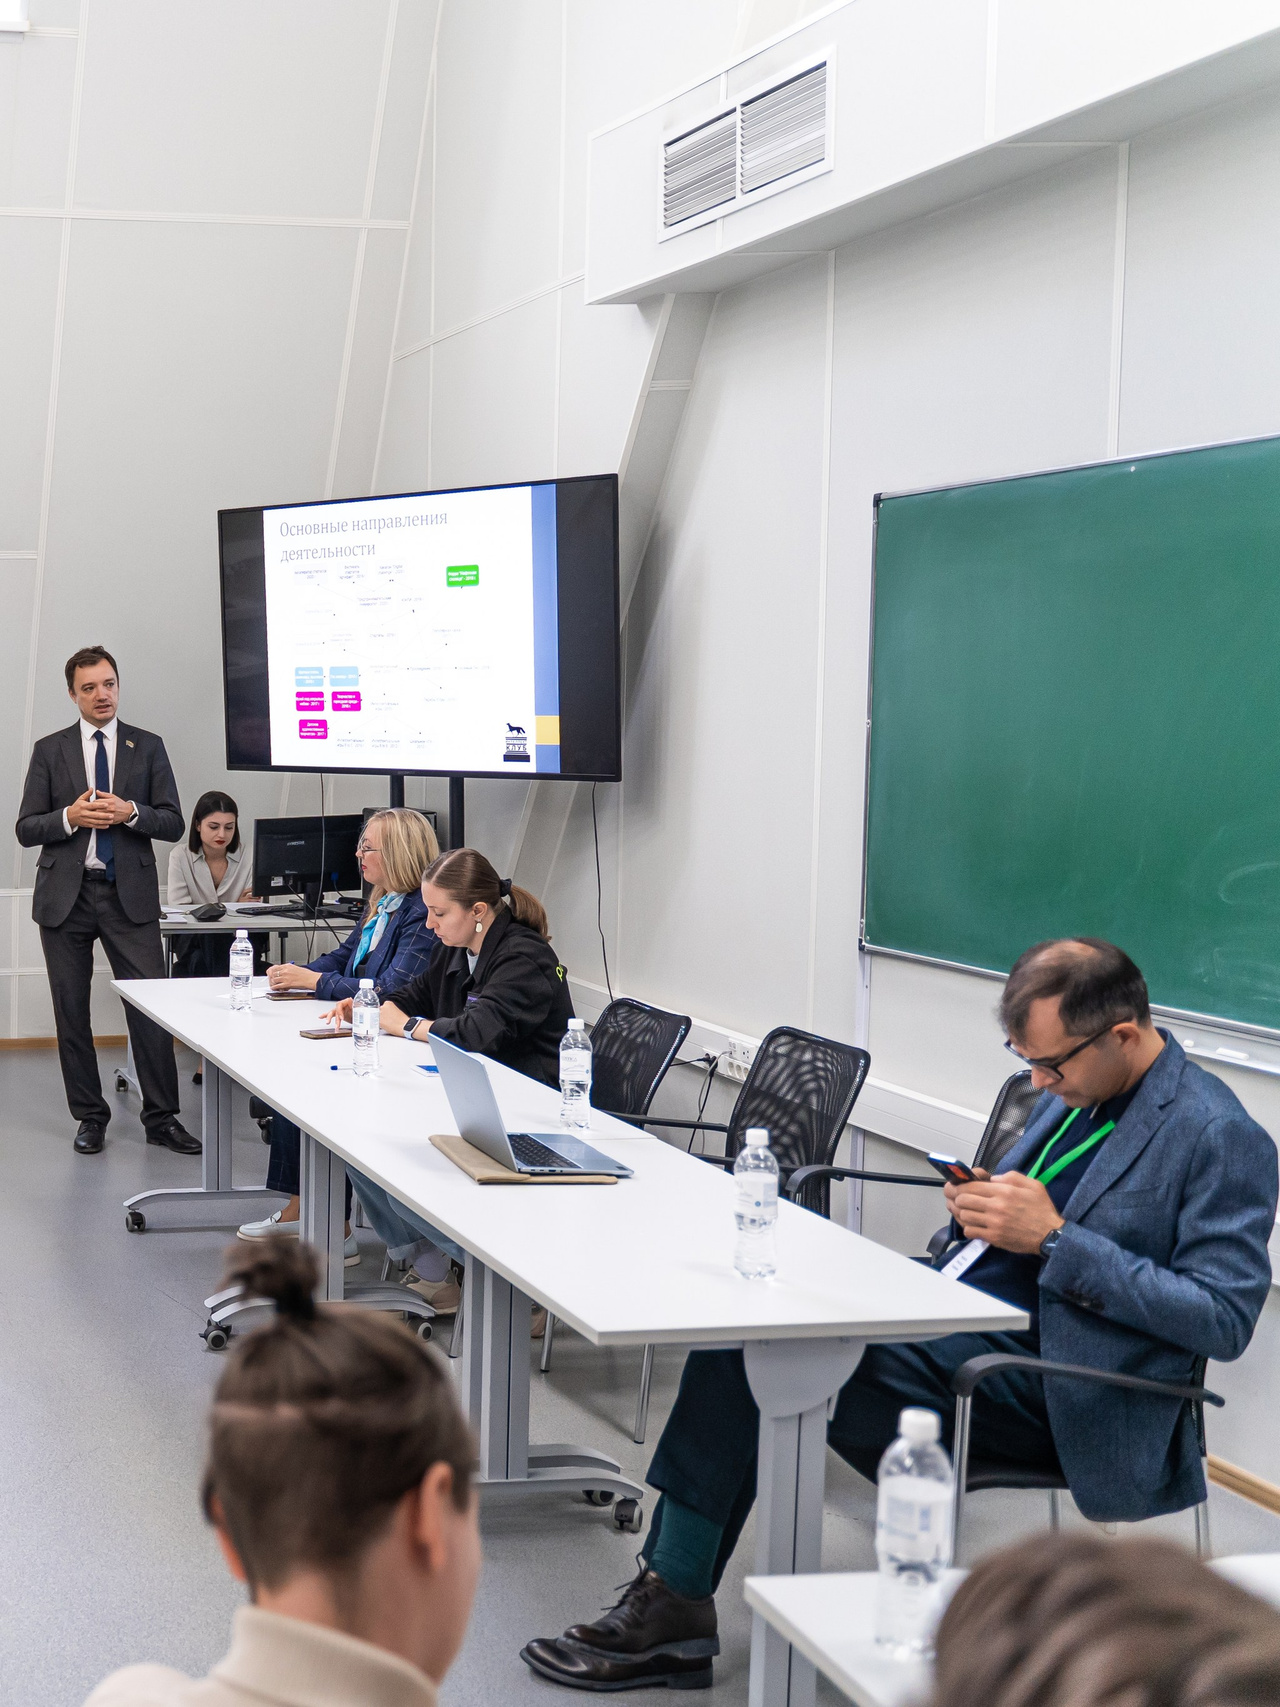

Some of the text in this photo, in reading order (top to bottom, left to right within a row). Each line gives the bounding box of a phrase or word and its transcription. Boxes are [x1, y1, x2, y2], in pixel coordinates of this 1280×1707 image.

[279, 512, 448, 537] Основные направления
[280, 543, 376, 564] деятельности
